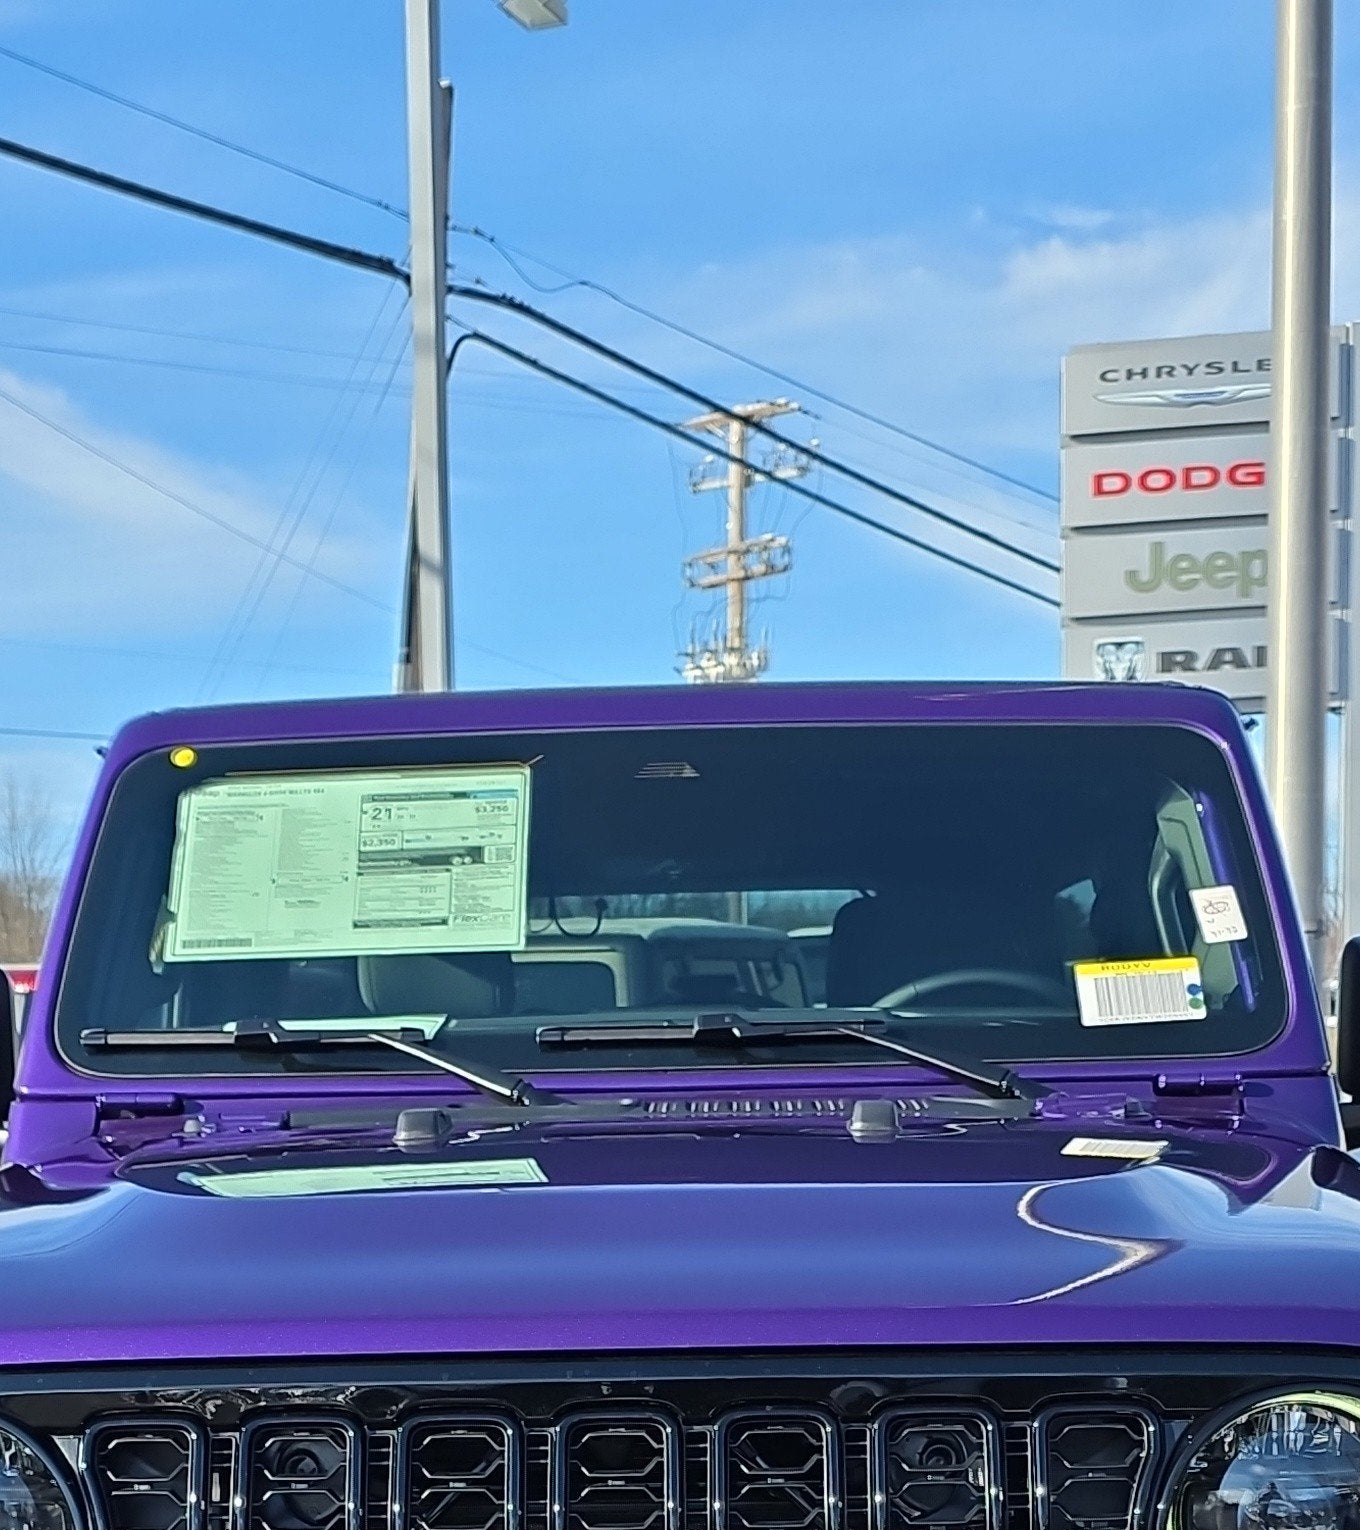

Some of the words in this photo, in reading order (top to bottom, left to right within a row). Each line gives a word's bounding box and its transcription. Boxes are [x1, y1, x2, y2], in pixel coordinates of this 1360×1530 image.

[1099, 357, 1272, 384] CHRYSLE
[1091, 461, 1266, 498] DODG
[1123, 541, 1269, 598] Jeep
[371, 807, 393, 821] 21
